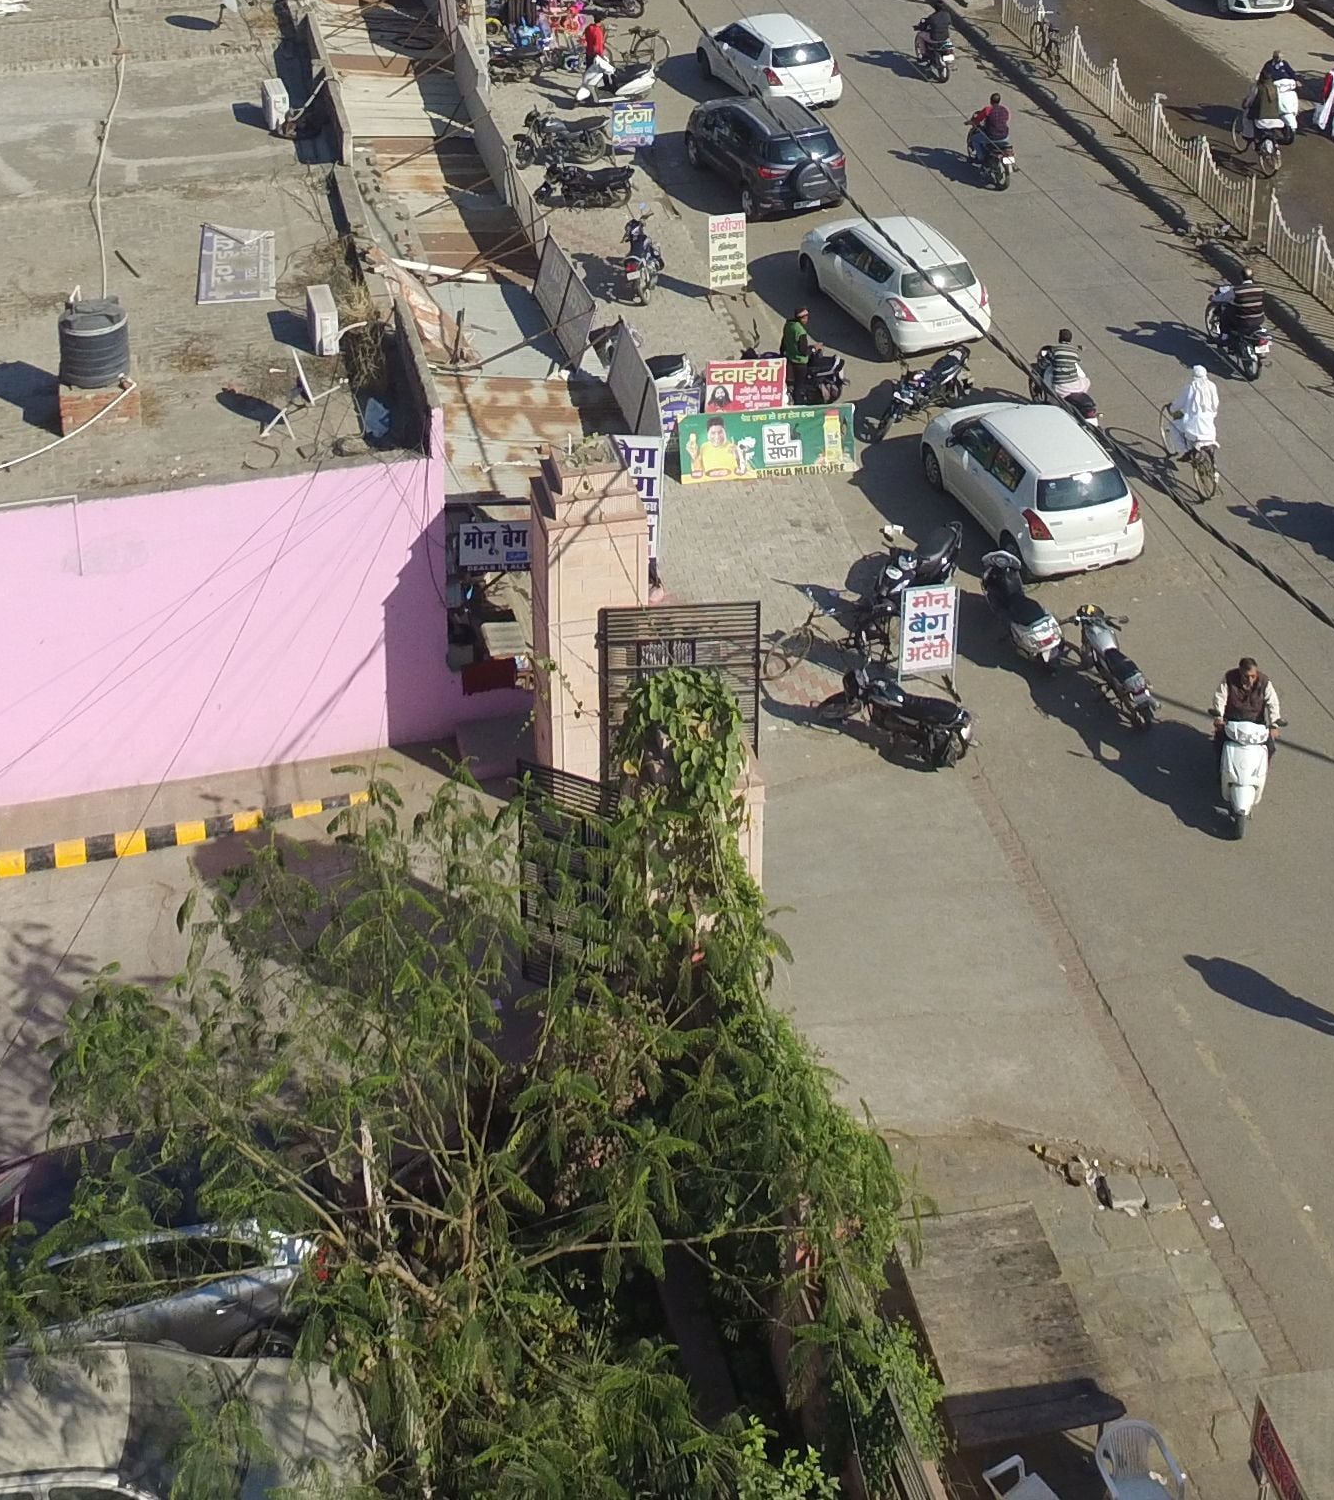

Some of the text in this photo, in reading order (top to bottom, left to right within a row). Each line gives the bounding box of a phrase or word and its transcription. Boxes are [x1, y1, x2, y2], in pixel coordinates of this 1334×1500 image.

[766, 428, 786, 446] पेट
[767, 443, 798, 460] सफा
[911, 591, 952, 609] मोनू
[908, 612, 950, 634] बैग
